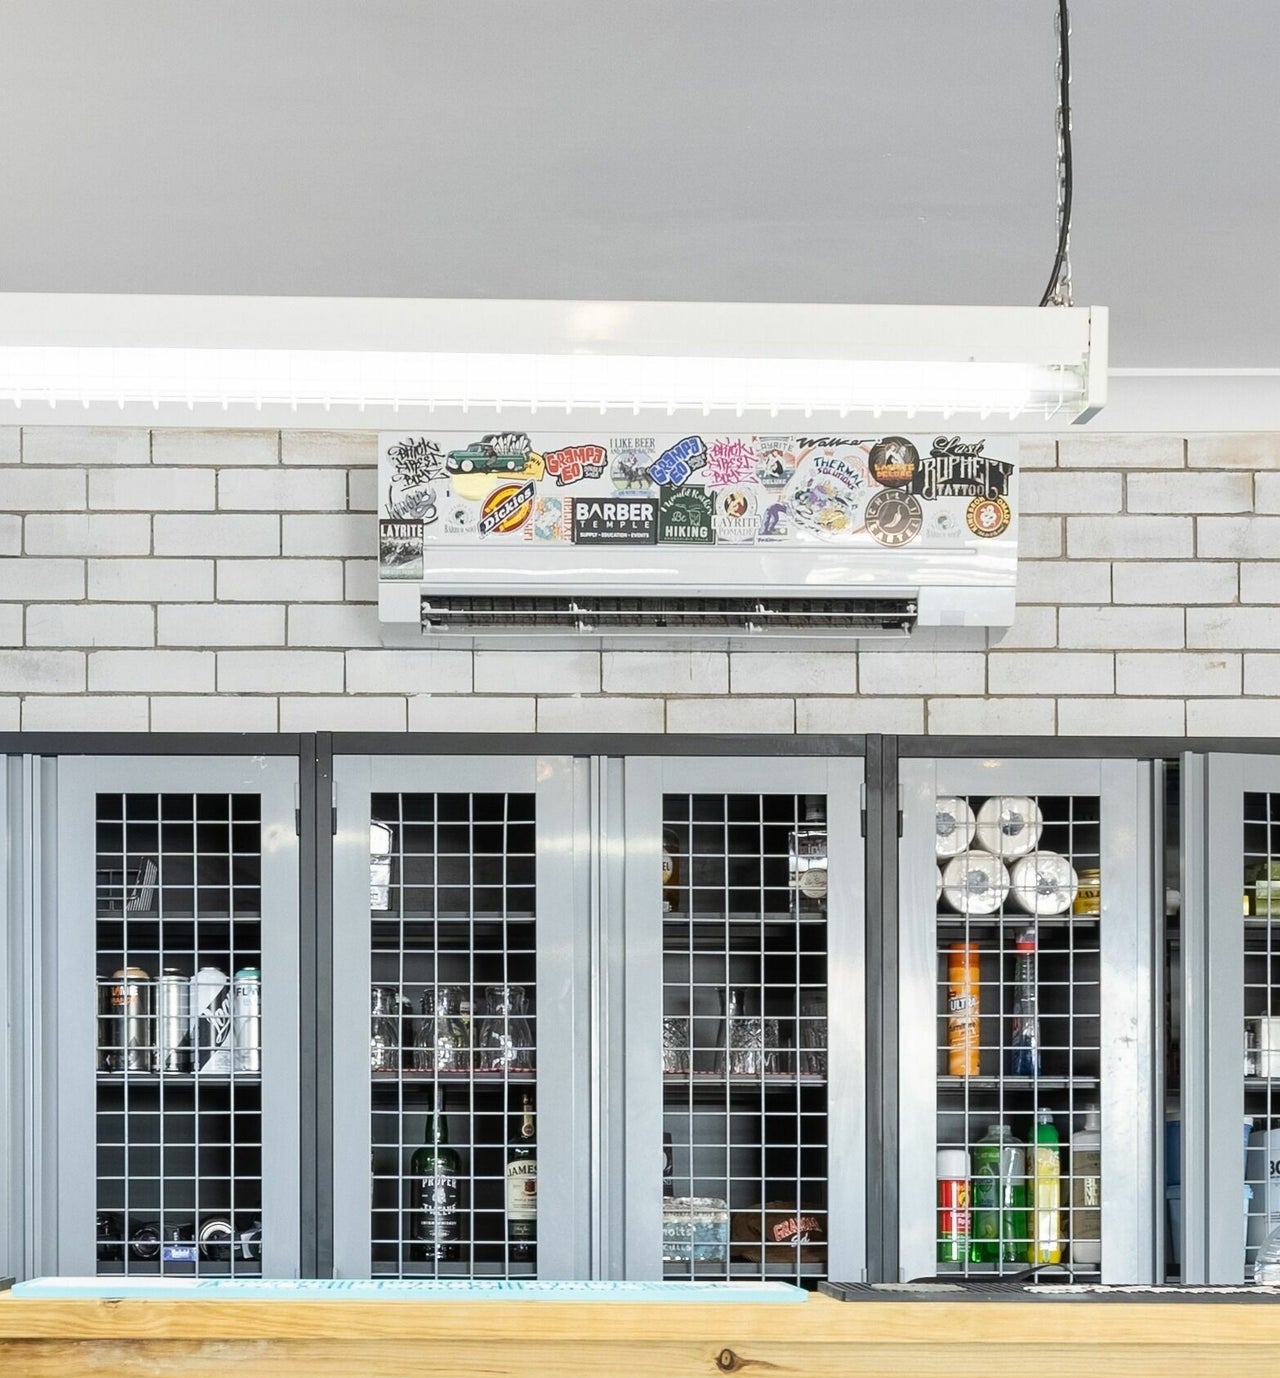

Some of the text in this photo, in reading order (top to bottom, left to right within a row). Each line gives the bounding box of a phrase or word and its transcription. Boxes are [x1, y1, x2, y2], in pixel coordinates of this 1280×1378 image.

[614, 438, 632, 448] LIKE
[634, 438, 656, 448] BEER
[814, 457, 865, 488] THERMAL
[937, 483, 984, 496] TATTOO
[483, 486, 533, 531] Dickies
[576, 503, 654, 521] BARBER
[580, 520, 650, 528] TEMPLE
[380, 524, 423, 538] LAYRITE
[664, 526, 708, 538] HIKING
